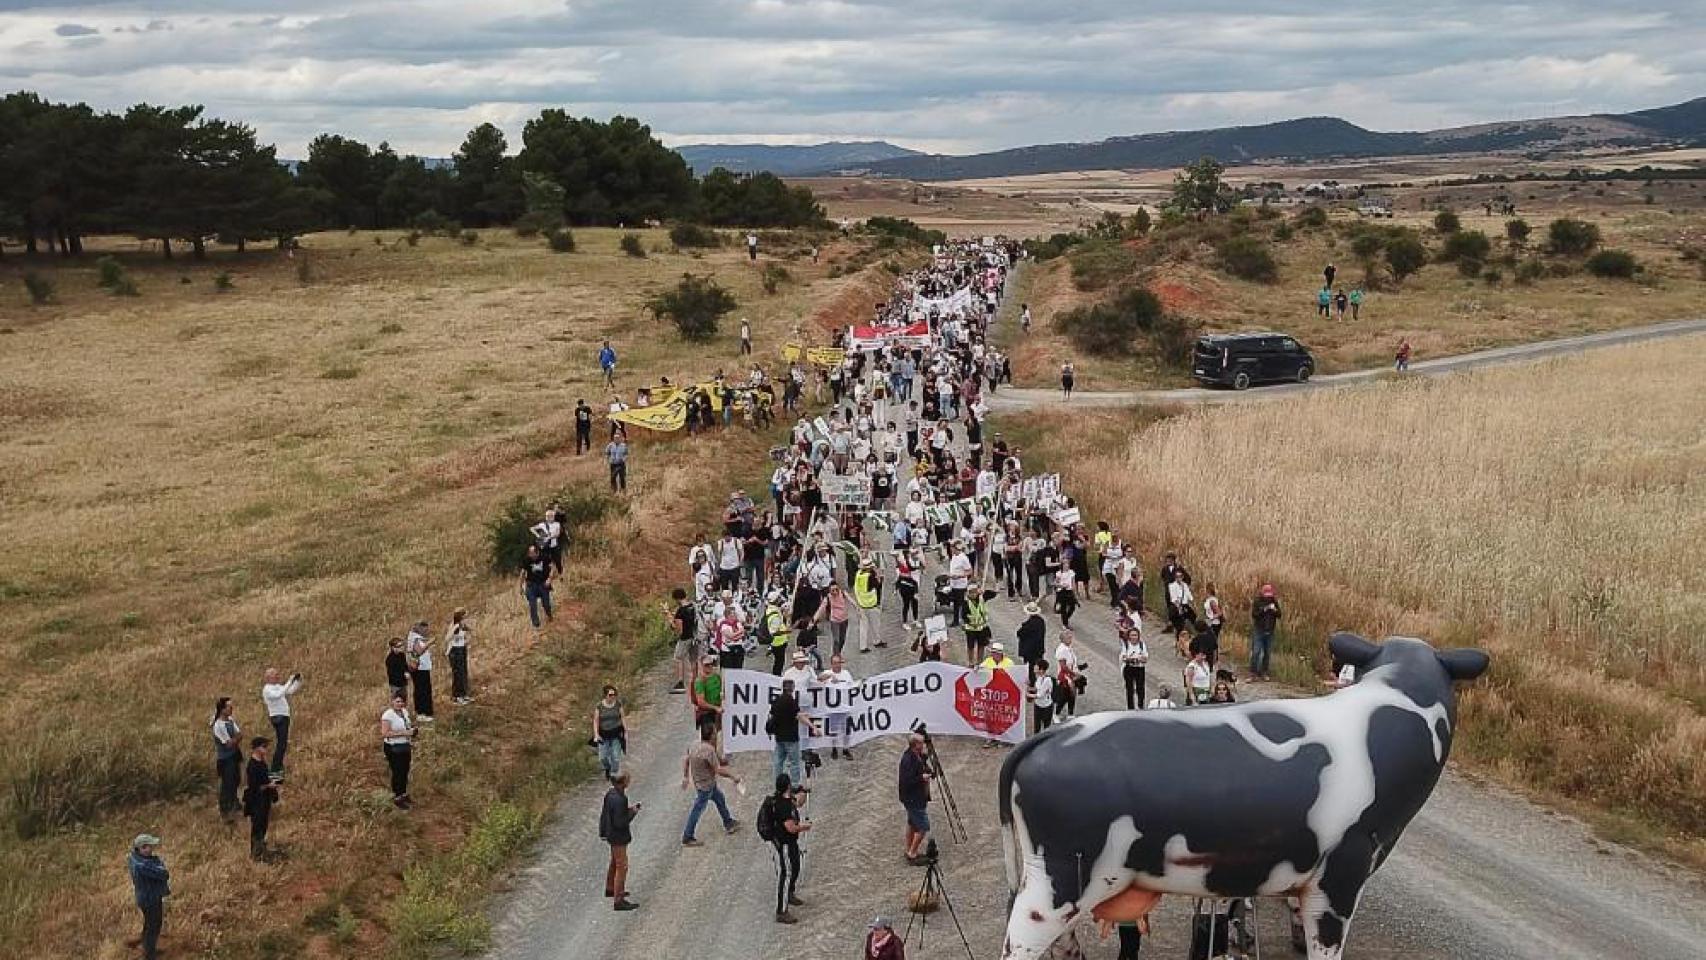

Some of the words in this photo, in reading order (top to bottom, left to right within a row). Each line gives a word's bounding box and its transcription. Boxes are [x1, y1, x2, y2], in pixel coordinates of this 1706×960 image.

[733, 683, 758, 705] NI
[807, 686, 842, 708] TU
[848, 671, 943, 707] PUEBLO
[980, 688, 1009, 702] STOP
[731, 714, 757, 737] NI
[846, 704, 892, 735] MÍO
